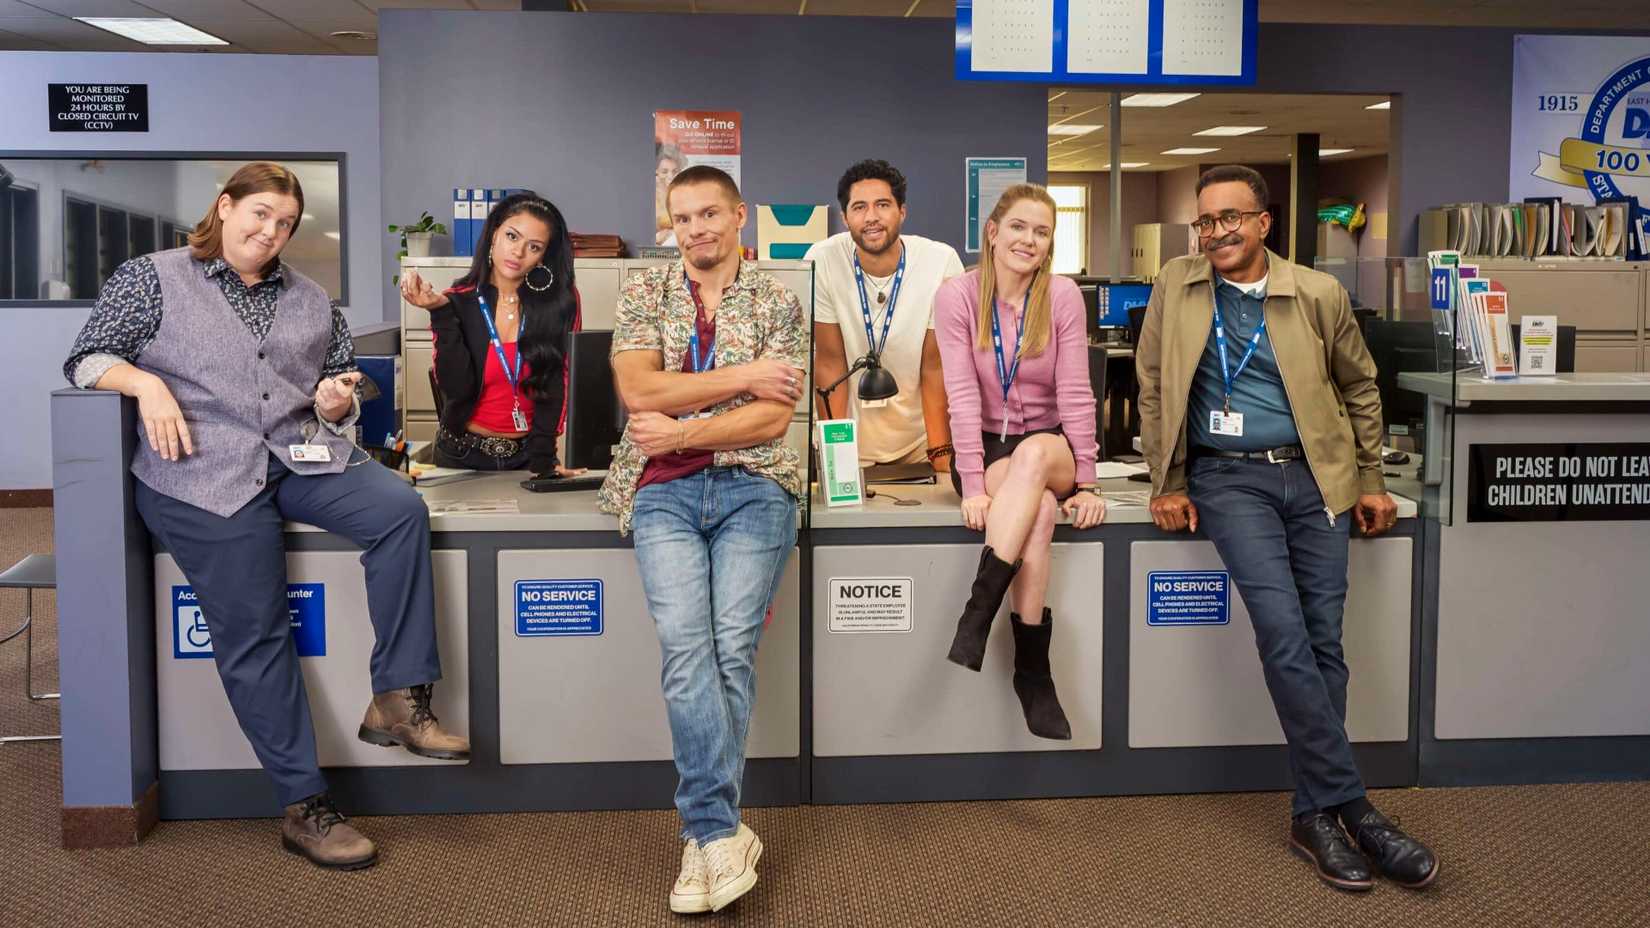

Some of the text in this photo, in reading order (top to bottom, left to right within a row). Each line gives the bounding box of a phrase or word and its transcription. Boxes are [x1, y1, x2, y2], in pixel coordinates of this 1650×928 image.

[1538, 96, 1578, 111] 1915
[1591, 70, 1642, 134] DEPARTMENT
[670, 118, 735, 129] Save Time
[1597, 150, 1640, 171] 100
[1593, 174, 1613, 198] STA
[1435, 276, 1446, 301] 11
[1496, 456, 1650, 478] PLEASE DO NOT LEA
[1488, 484, 1566, 506] CHILDREN
[288, 590, 313, 598] unter
[522, 590, 596, 601] NO SERVICE
[840, 585, 902, 598] NOTICE
[1154, 582, 1223, 592] NO SERVICE
